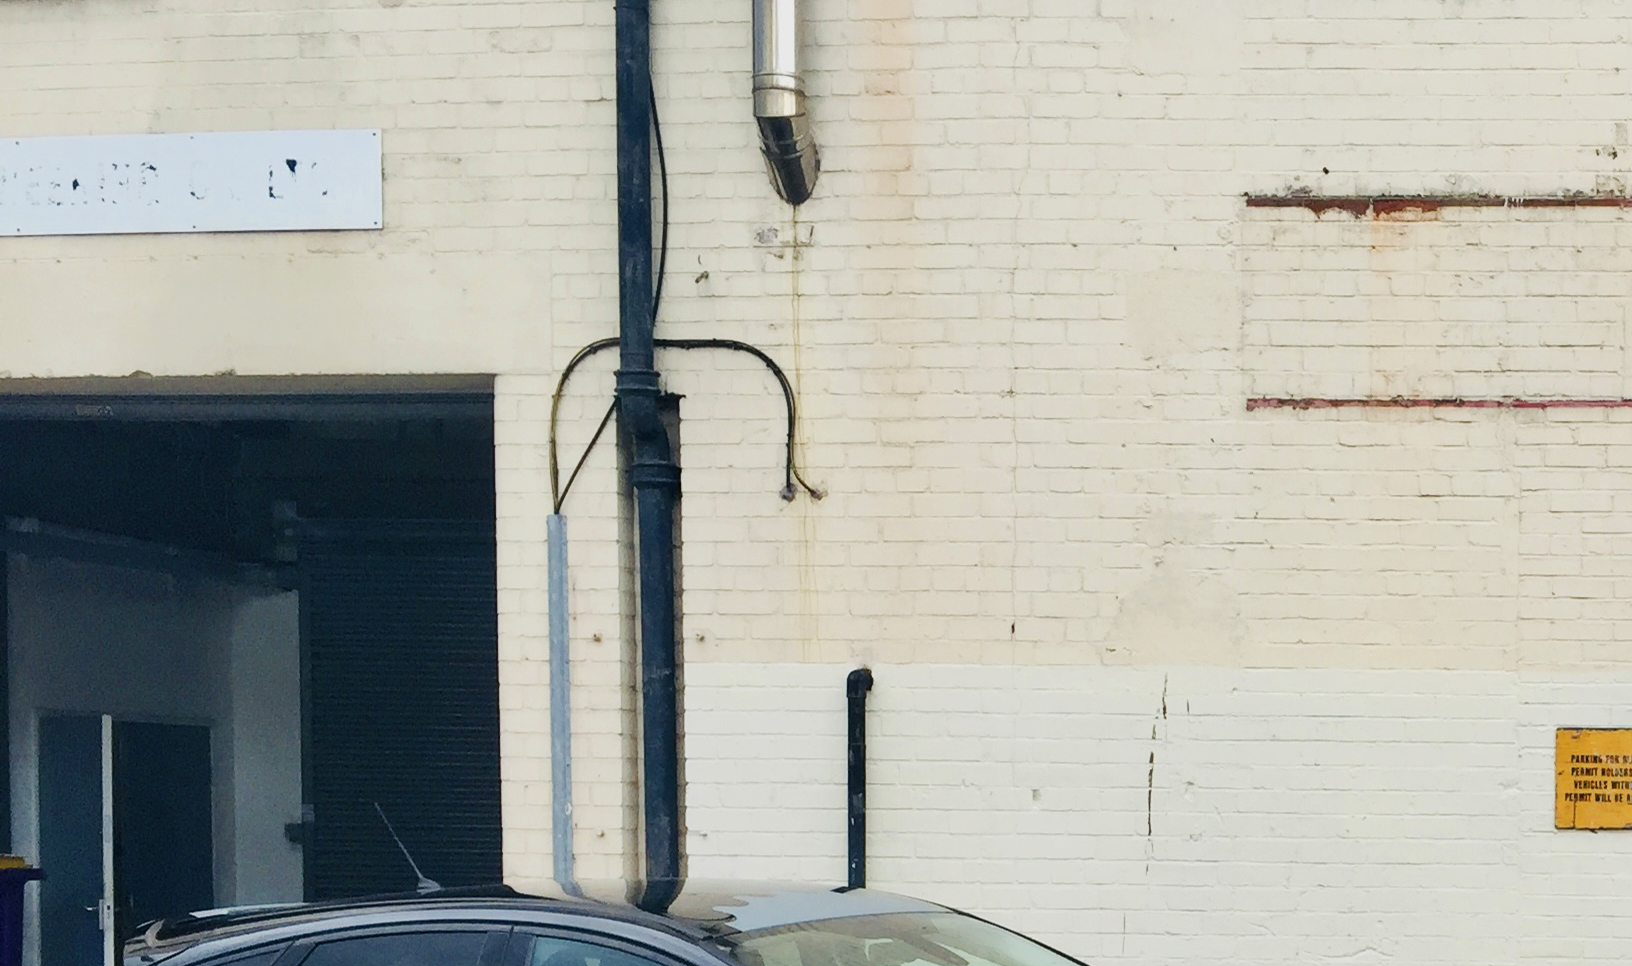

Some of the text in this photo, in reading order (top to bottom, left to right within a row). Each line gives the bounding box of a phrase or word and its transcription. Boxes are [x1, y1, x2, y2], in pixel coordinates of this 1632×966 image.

[1571, 754, 1603, 764] PARKING
[1571, 767, 1598, 777] PERMIT
[1573, 780, 1608, 790] VEHICLES
[1564, 792, 1592, 802] PERMIT
[1595, 793, 1612, 803] WILL
[1615, 793, 1623, 803] BE
